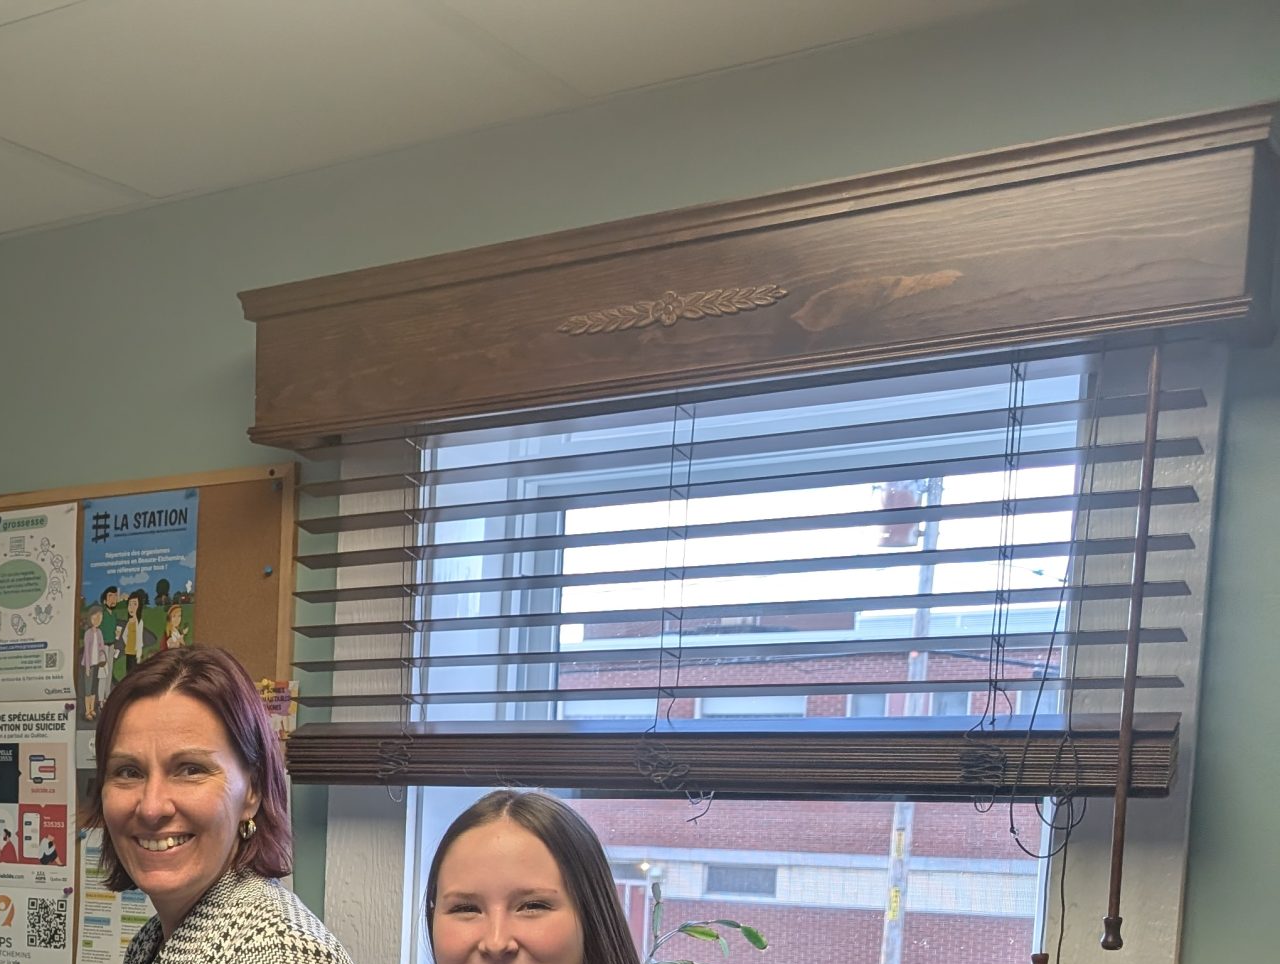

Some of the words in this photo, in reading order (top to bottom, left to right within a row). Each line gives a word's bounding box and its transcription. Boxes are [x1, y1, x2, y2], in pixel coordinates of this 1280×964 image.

[113, 513, 129, 531] LA
[133, 507, 188, 530] STATION
[7, 711, 57, 722] SPÉCIALISÉE
[57, 713, 68, 721] EN
[22, 723, 33, 731] DU
[35, 722, 66, 731] SUICIDE
